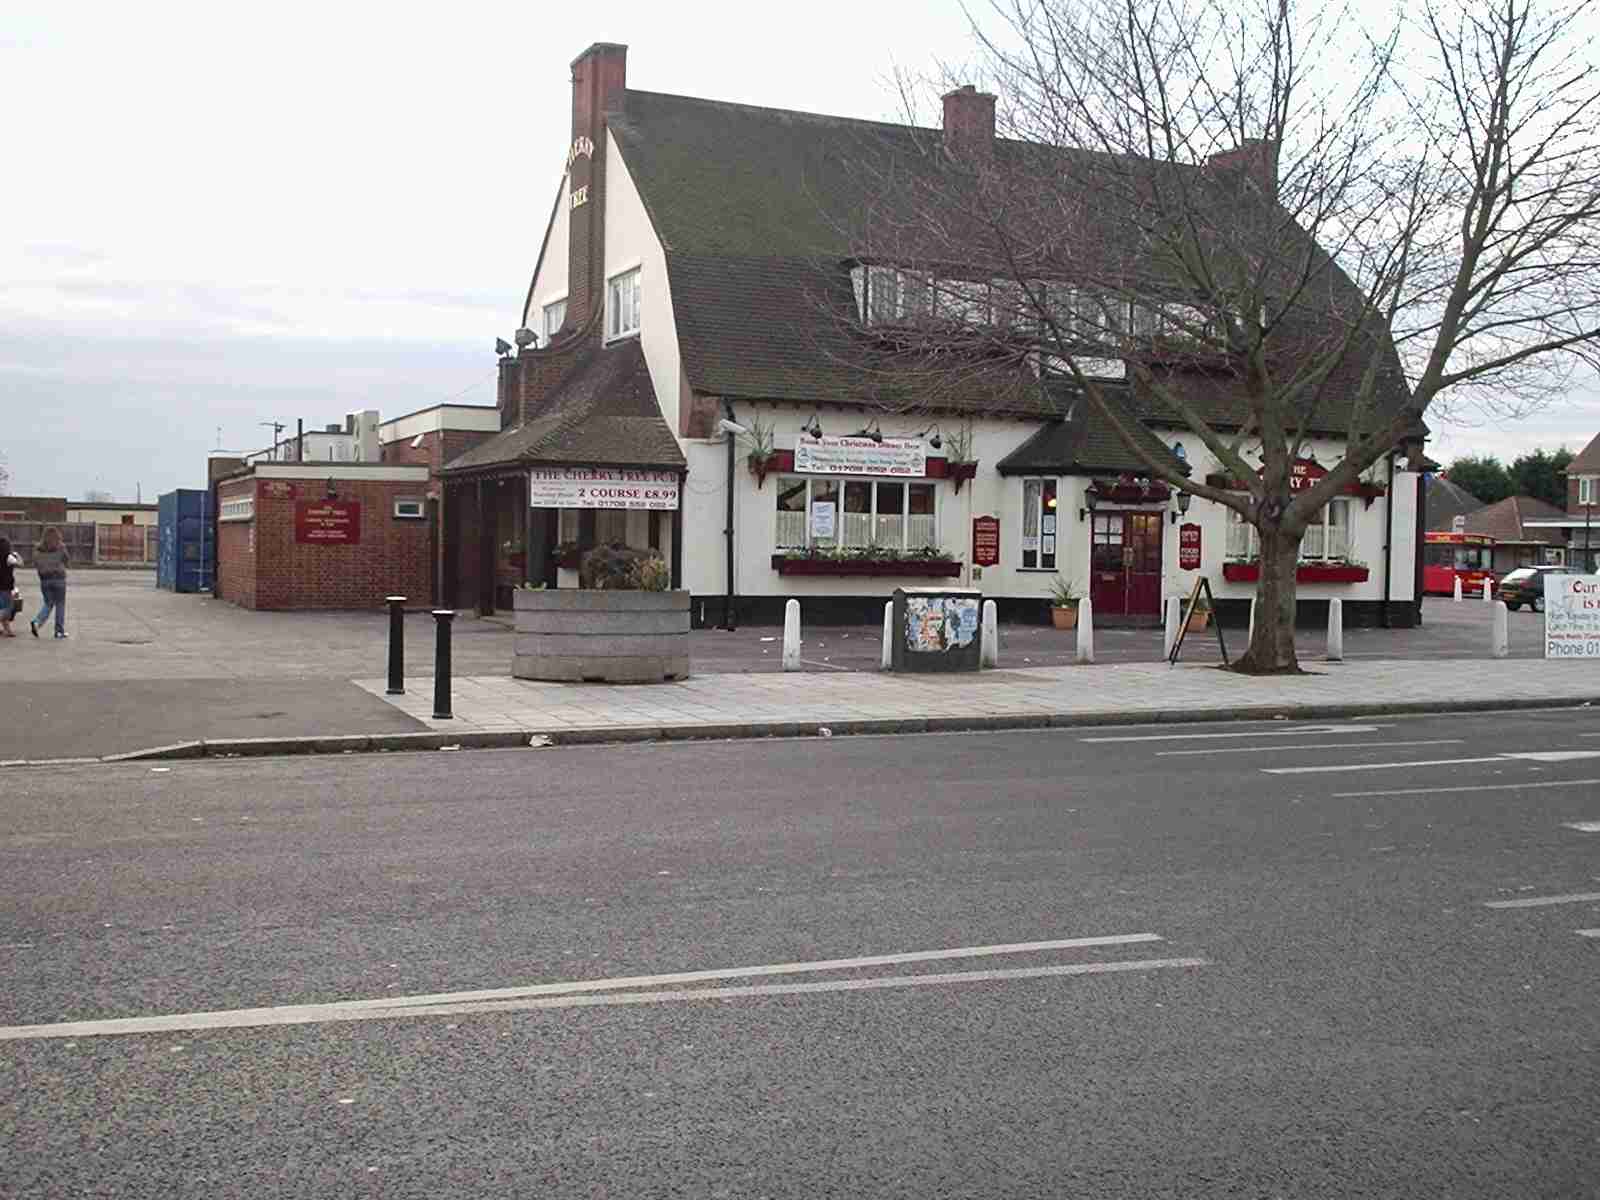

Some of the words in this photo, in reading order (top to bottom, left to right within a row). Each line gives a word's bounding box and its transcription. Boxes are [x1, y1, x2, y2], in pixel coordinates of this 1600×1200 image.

[840, 439, 876, 449] Christmas
[536, 471, 560, 481] THE
[564, 471, 613, 482] CHERRY
[578, 488, 585, 498] 2
[590, 488, 641, 499] COURSE
[645, 489, 676, 500] £8.99
[1548, 641, 1584, 656] Phone
